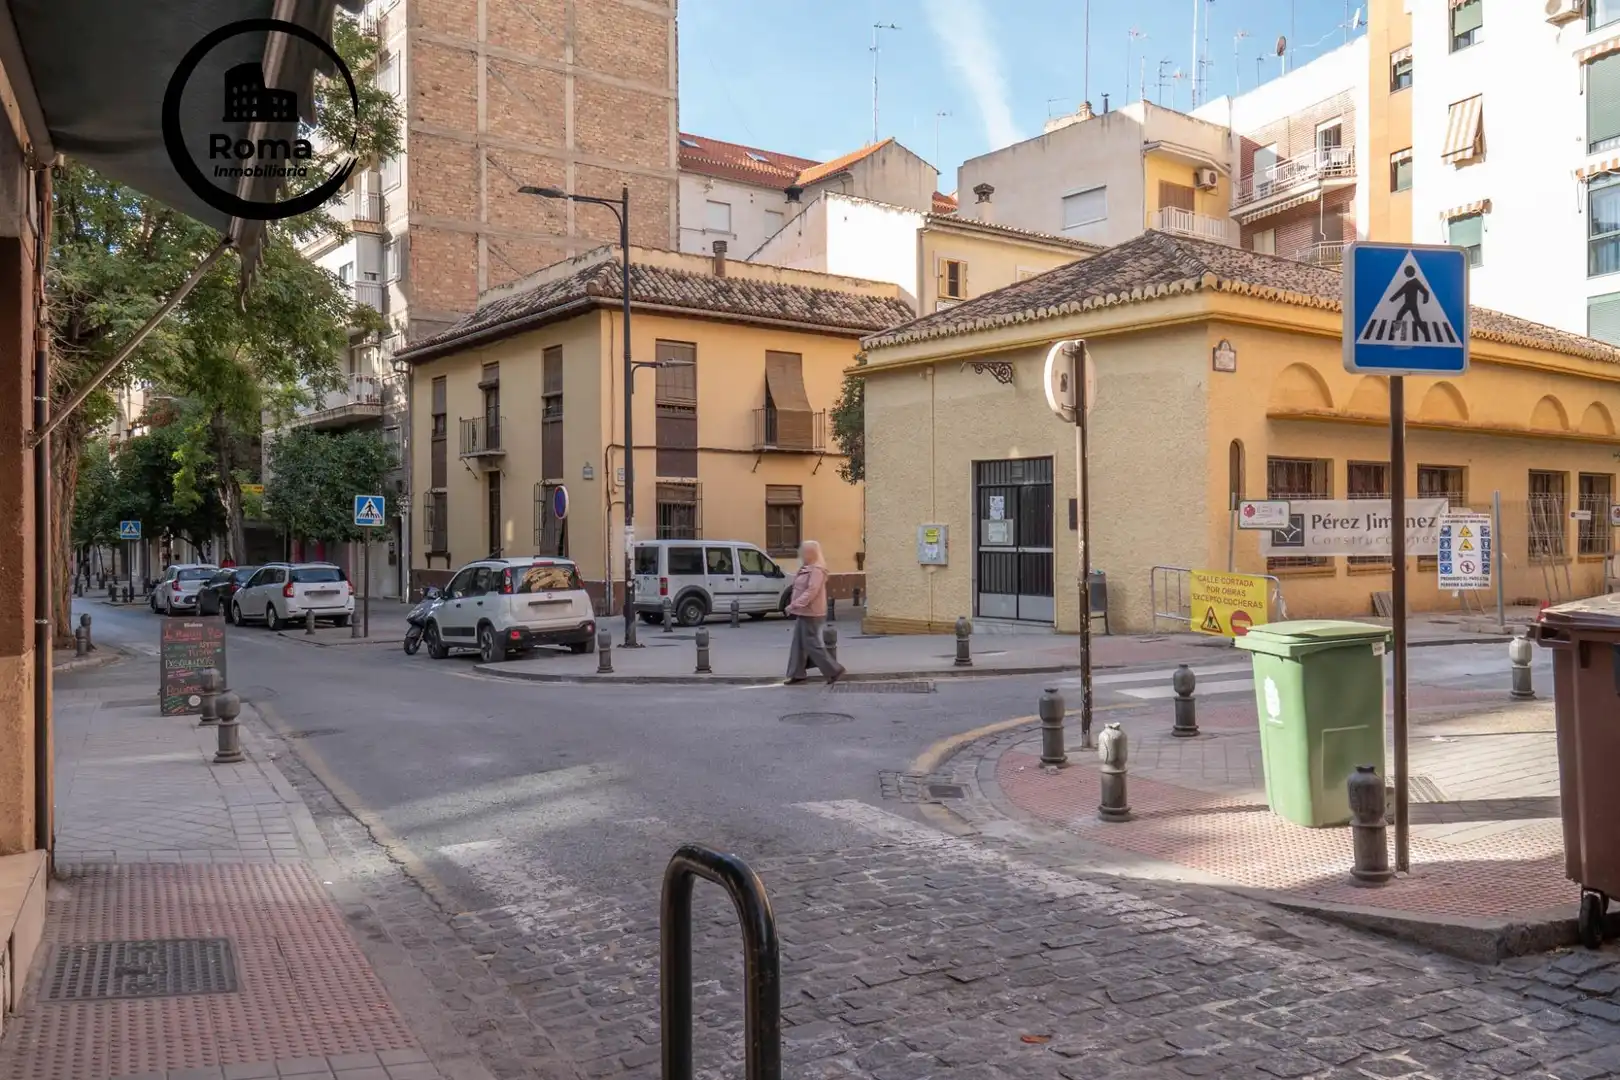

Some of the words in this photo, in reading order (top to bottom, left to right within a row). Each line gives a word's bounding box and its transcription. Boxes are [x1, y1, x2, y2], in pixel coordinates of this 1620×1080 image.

[1312, 513, 1360, 529] Pérez
[1366, 512, 1437, 531] Jimnez
[1198, 575, 1220, 584] CALLE
[1220, 577, 1255, 588] CORTADA
[1206, 585, 1220, 593] POR
[1221, 587, 1247, 597] OBRAS
[1192, 593, 1222, 604] EXCEPTO
[1223, 598, 1264, 609] COCHERAS
